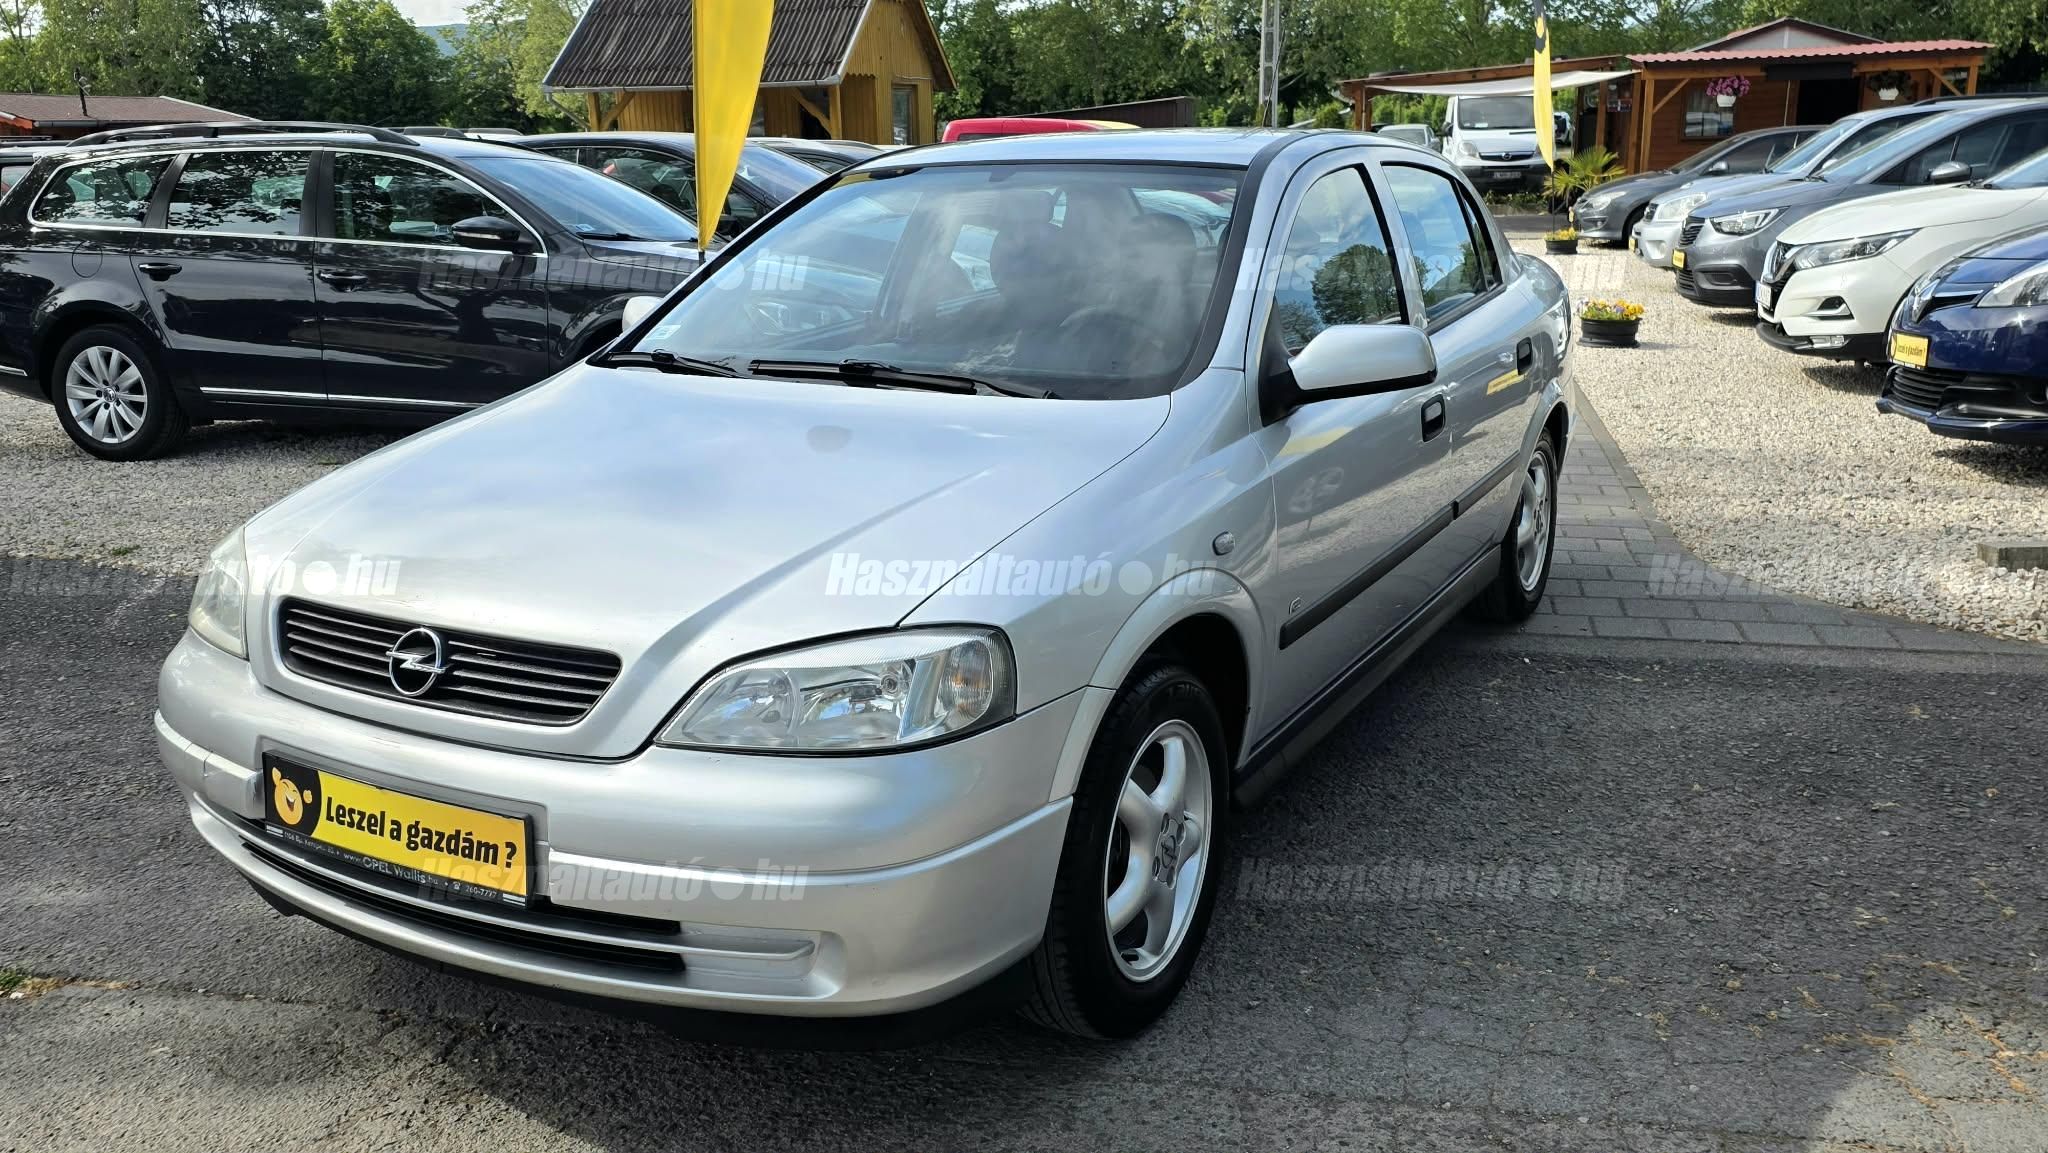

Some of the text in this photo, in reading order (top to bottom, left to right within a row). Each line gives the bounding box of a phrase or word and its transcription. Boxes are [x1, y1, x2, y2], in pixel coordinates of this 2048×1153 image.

[325, 796, 517, 869] Leszel a gazdám ?
